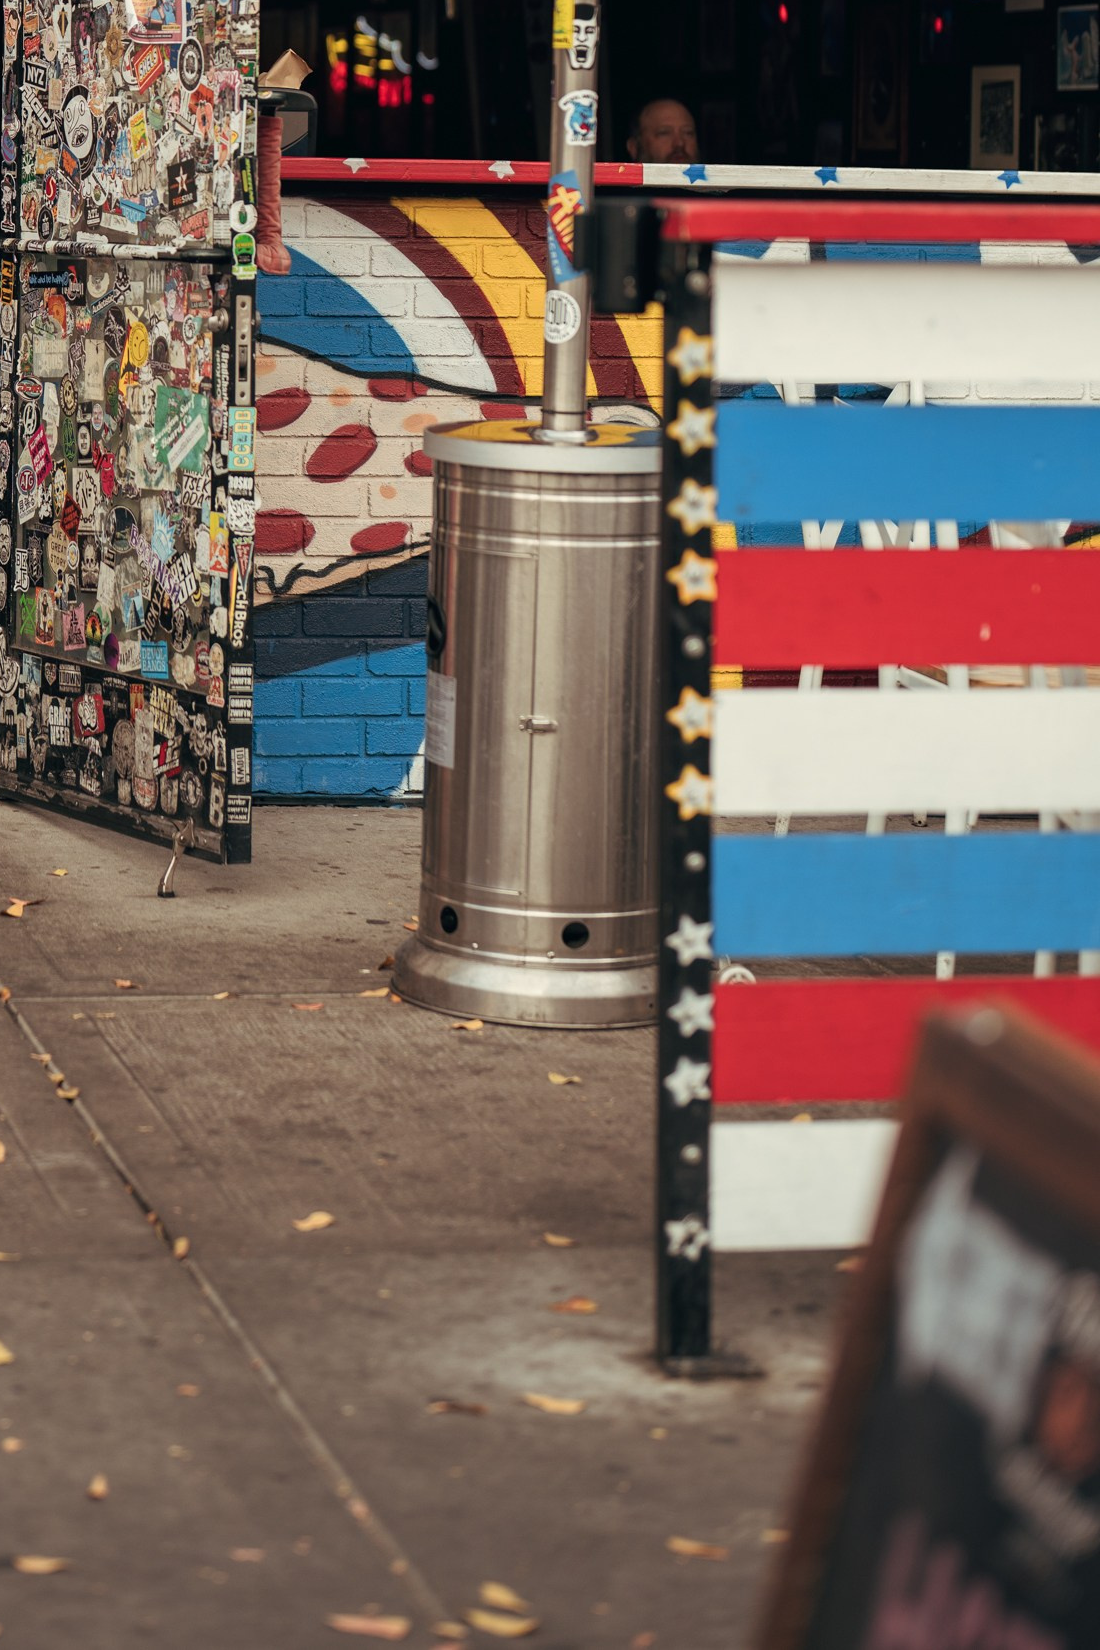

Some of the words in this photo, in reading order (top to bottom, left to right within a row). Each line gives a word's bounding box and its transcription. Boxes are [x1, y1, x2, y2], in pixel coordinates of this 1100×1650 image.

[27, 64, 45, 85] NYZ
[50, 542, 67, 553] GREAT
[142, 660, 166, 672] BANGS
